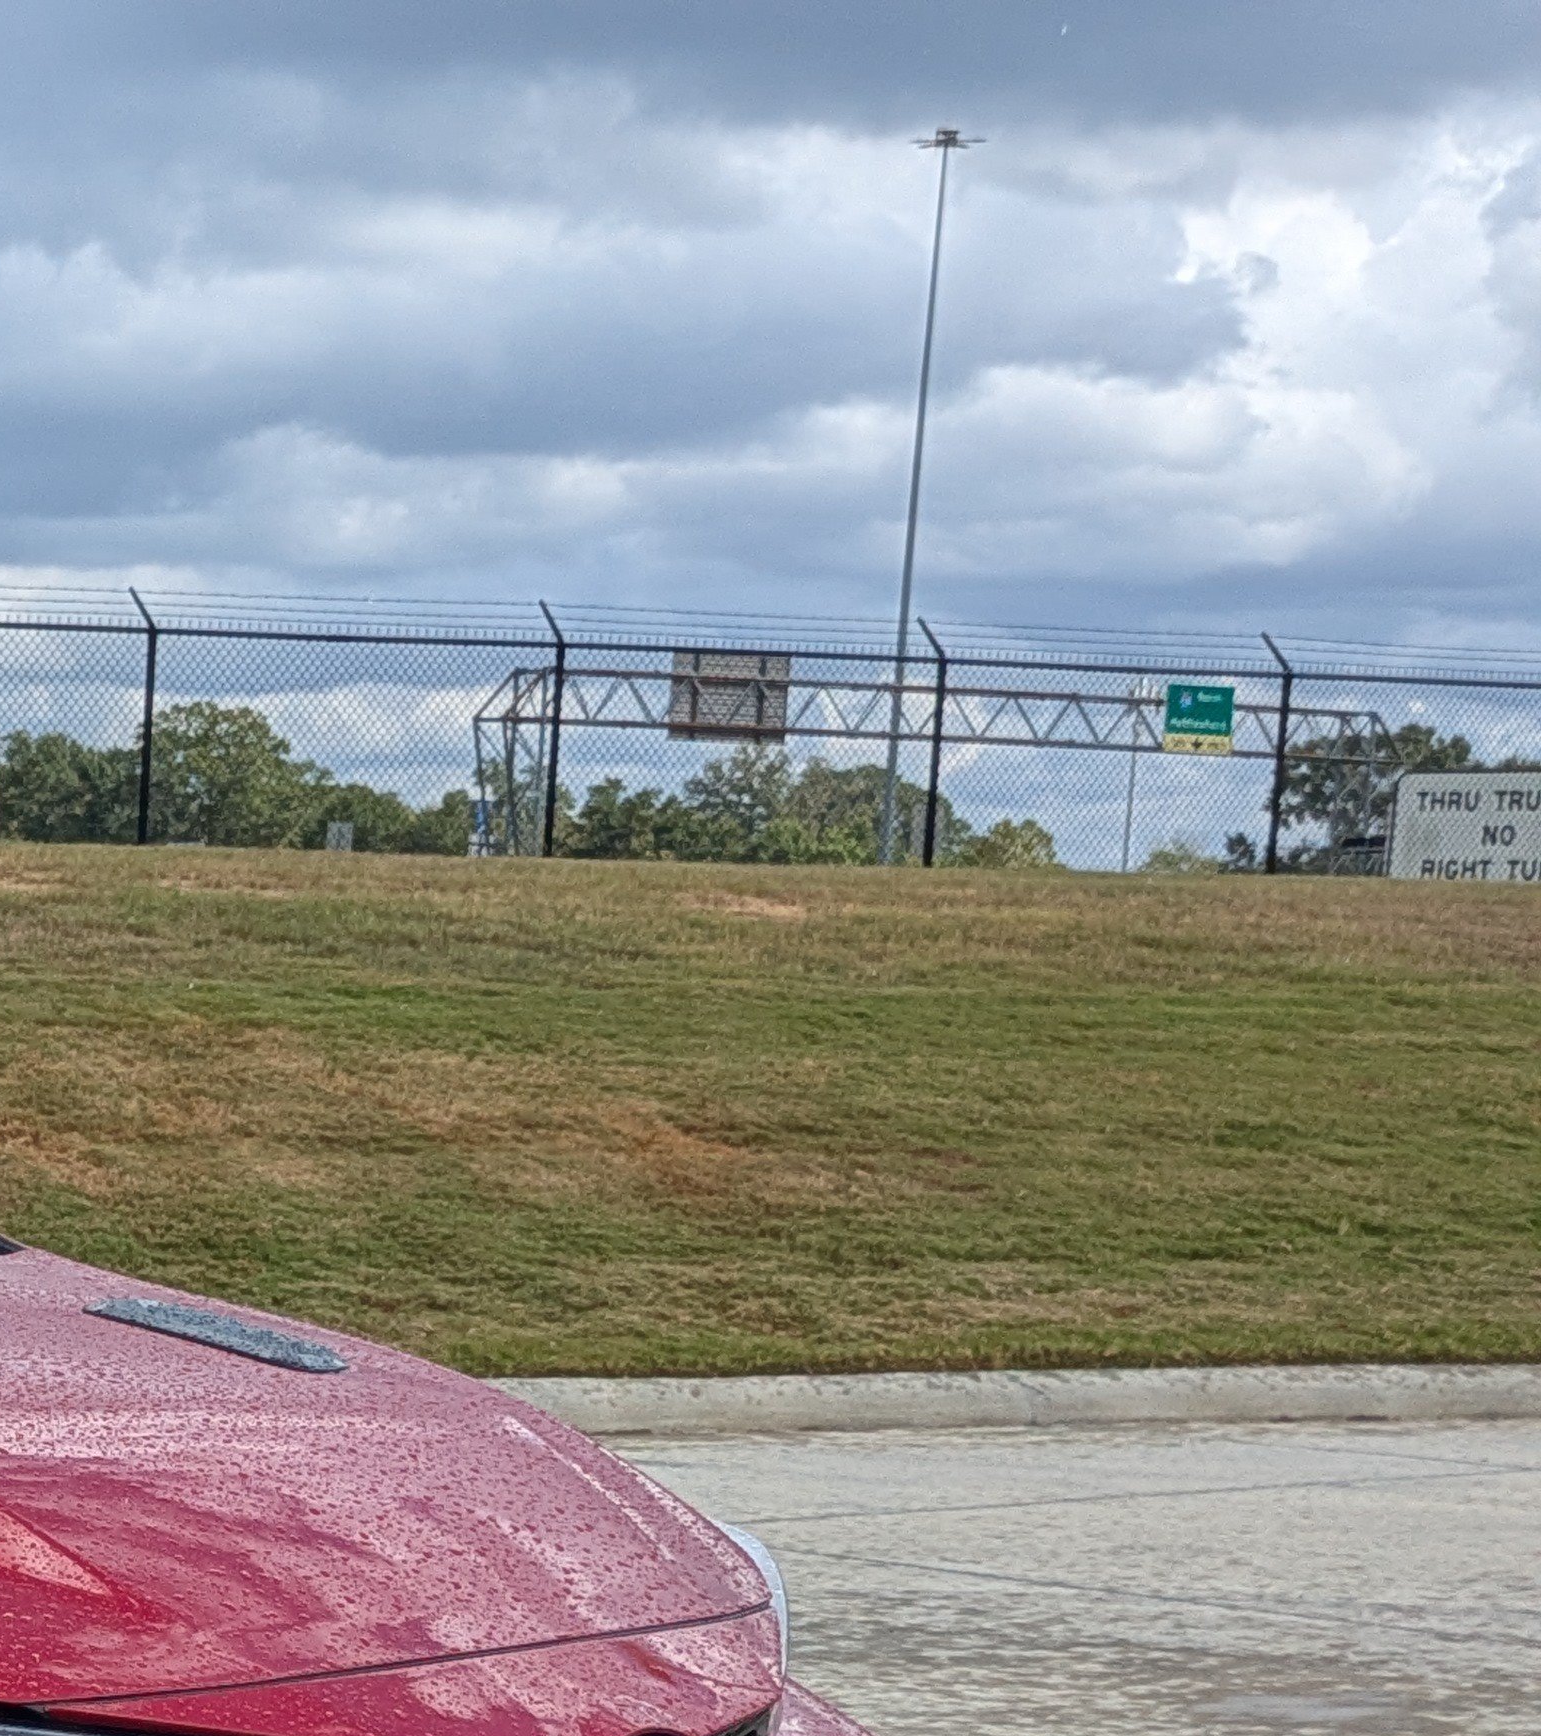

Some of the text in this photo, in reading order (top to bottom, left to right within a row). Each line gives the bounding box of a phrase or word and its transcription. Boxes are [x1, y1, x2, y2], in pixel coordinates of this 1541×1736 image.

[1417, 790, 1480, 812] THRU
[1481, 824, 1516, 847] NO
[1421, 858, 1541, 882] RIGHT TU
